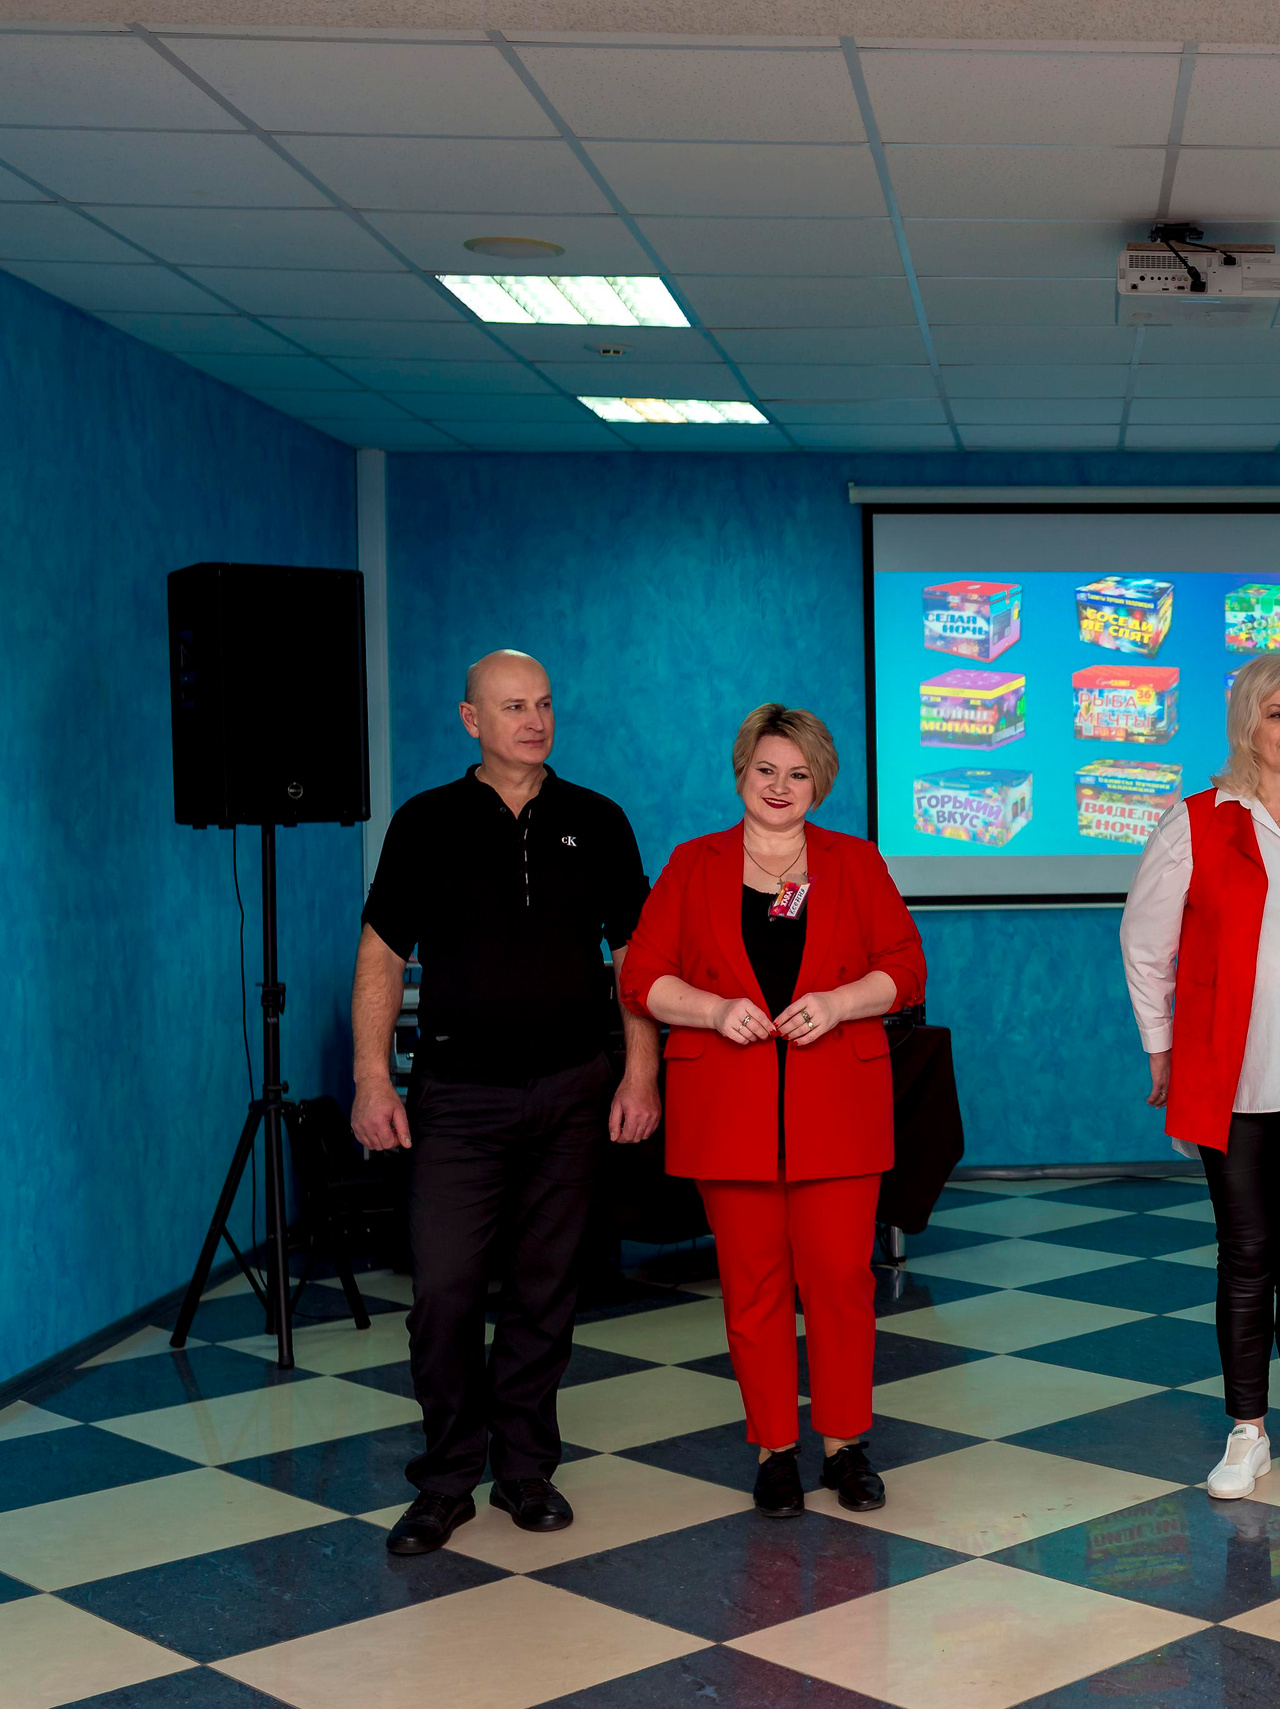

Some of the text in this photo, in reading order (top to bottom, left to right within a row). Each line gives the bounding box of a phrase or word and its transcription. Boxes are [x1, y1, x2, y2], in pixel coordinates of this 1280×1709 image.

[1086, 608, 1154, 633] СОСЕДИ
[942, 624, 988, 636] НОЧЬ
[1081, 619, 1153, 644] НЕ СПЯТ
[1079, 692, 1137, 709] РЫБА
[1137, 689, 1152, 700] 36
[920, 720, 994, 735] МОНАКО
[1078, 711, 1151, 729] МЕЧТЫ
[916, 795, 1003, 821] ГОРЬКИЙ
[936, 810, 981, 829] ВКУС
